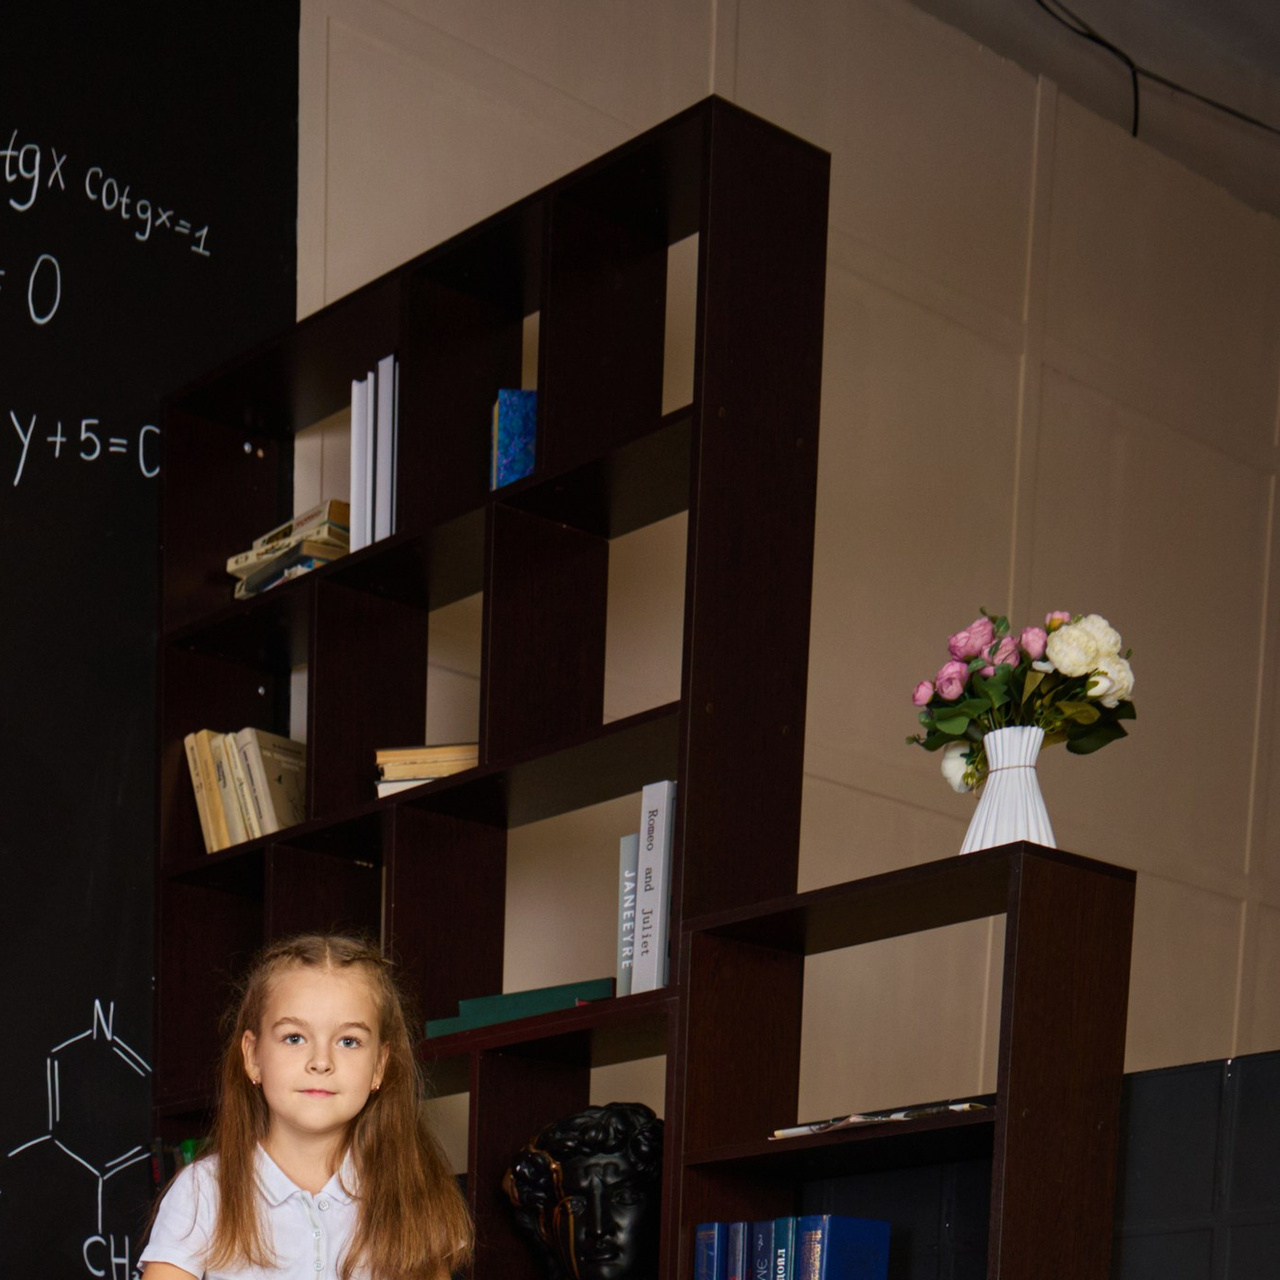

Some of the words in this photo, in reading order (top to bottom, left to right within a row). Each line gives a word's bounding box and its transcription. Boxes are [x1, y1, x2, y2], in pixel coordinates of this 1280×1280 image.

[646, 808, 659, 851] Romeo
[643, 866, 655, 893] and
[640, 908, 654, 957] Juliet
[92, 998, 114, 1040] N
